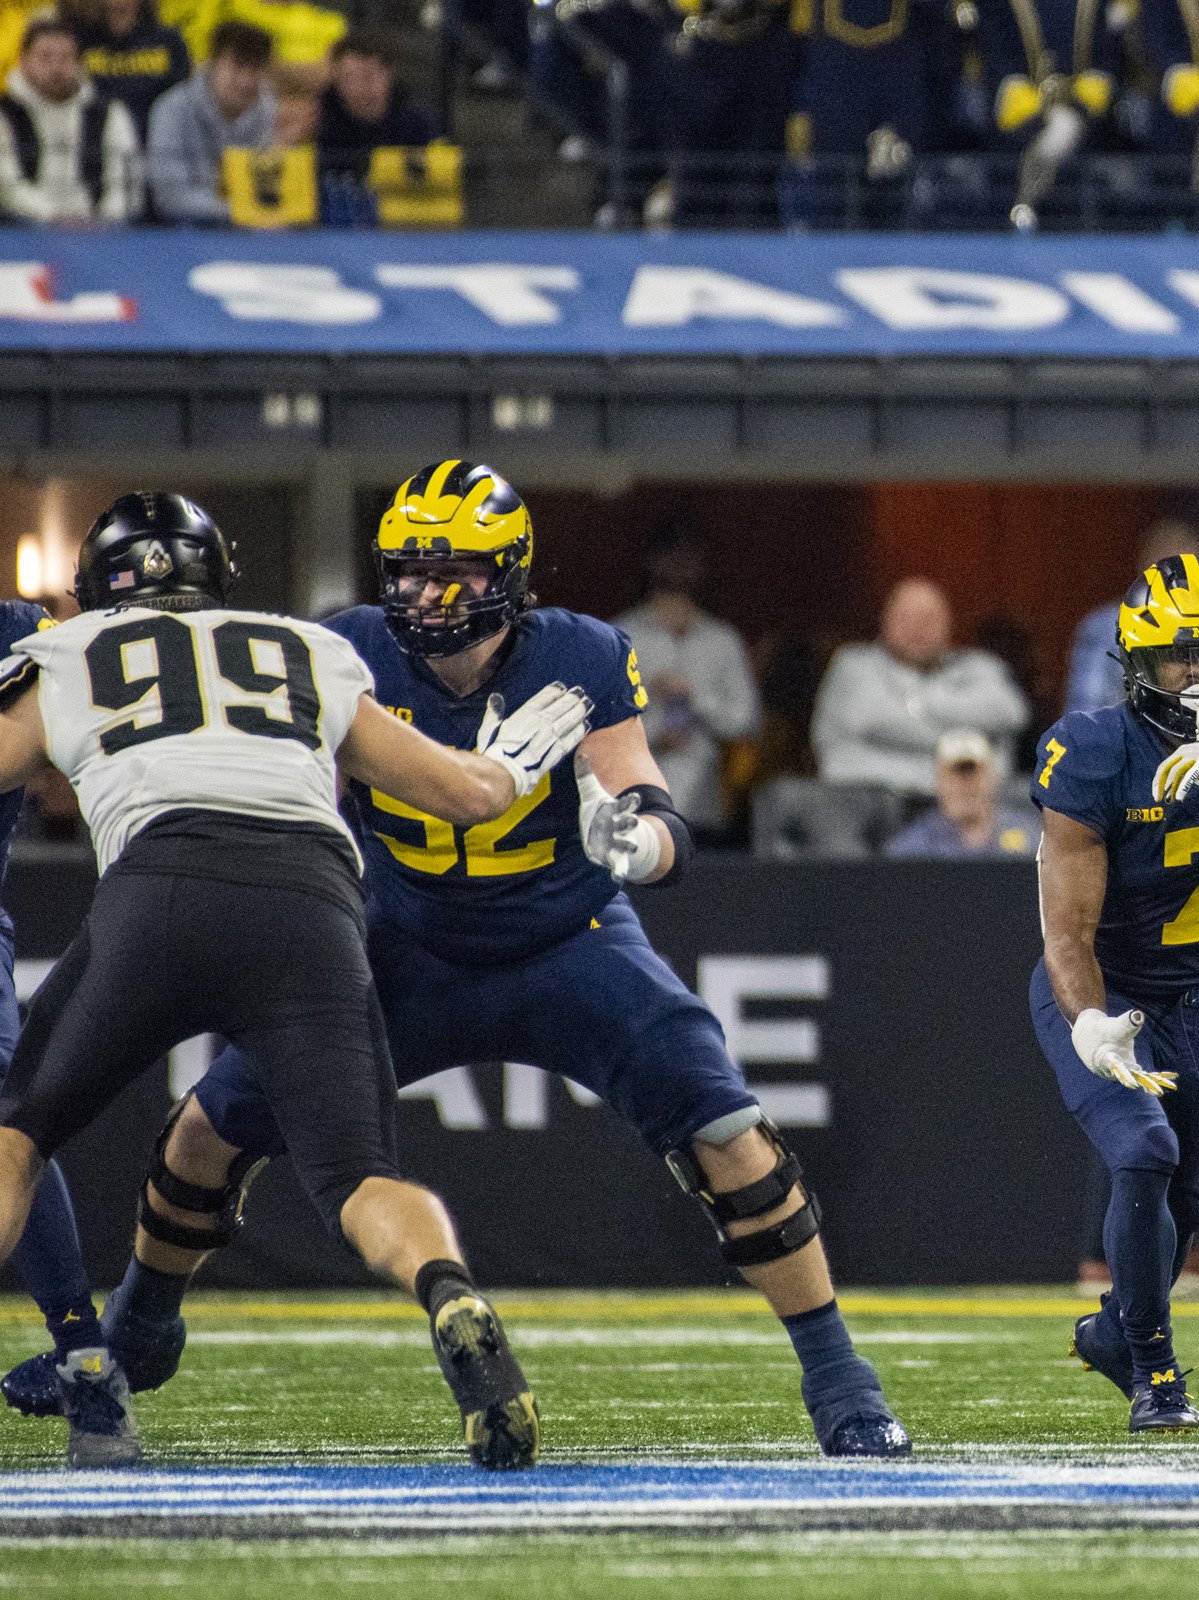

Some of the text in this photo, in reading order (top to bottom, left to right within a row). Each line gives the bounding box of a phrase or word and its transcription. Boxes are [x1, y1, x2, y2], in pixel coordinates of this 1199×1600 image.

[417, 537, 432, 548] M
[82, 612, 325, 757] 99
[1039, 737, 1067, 789] 7
[1151, 1369, 1176, 1385] M
